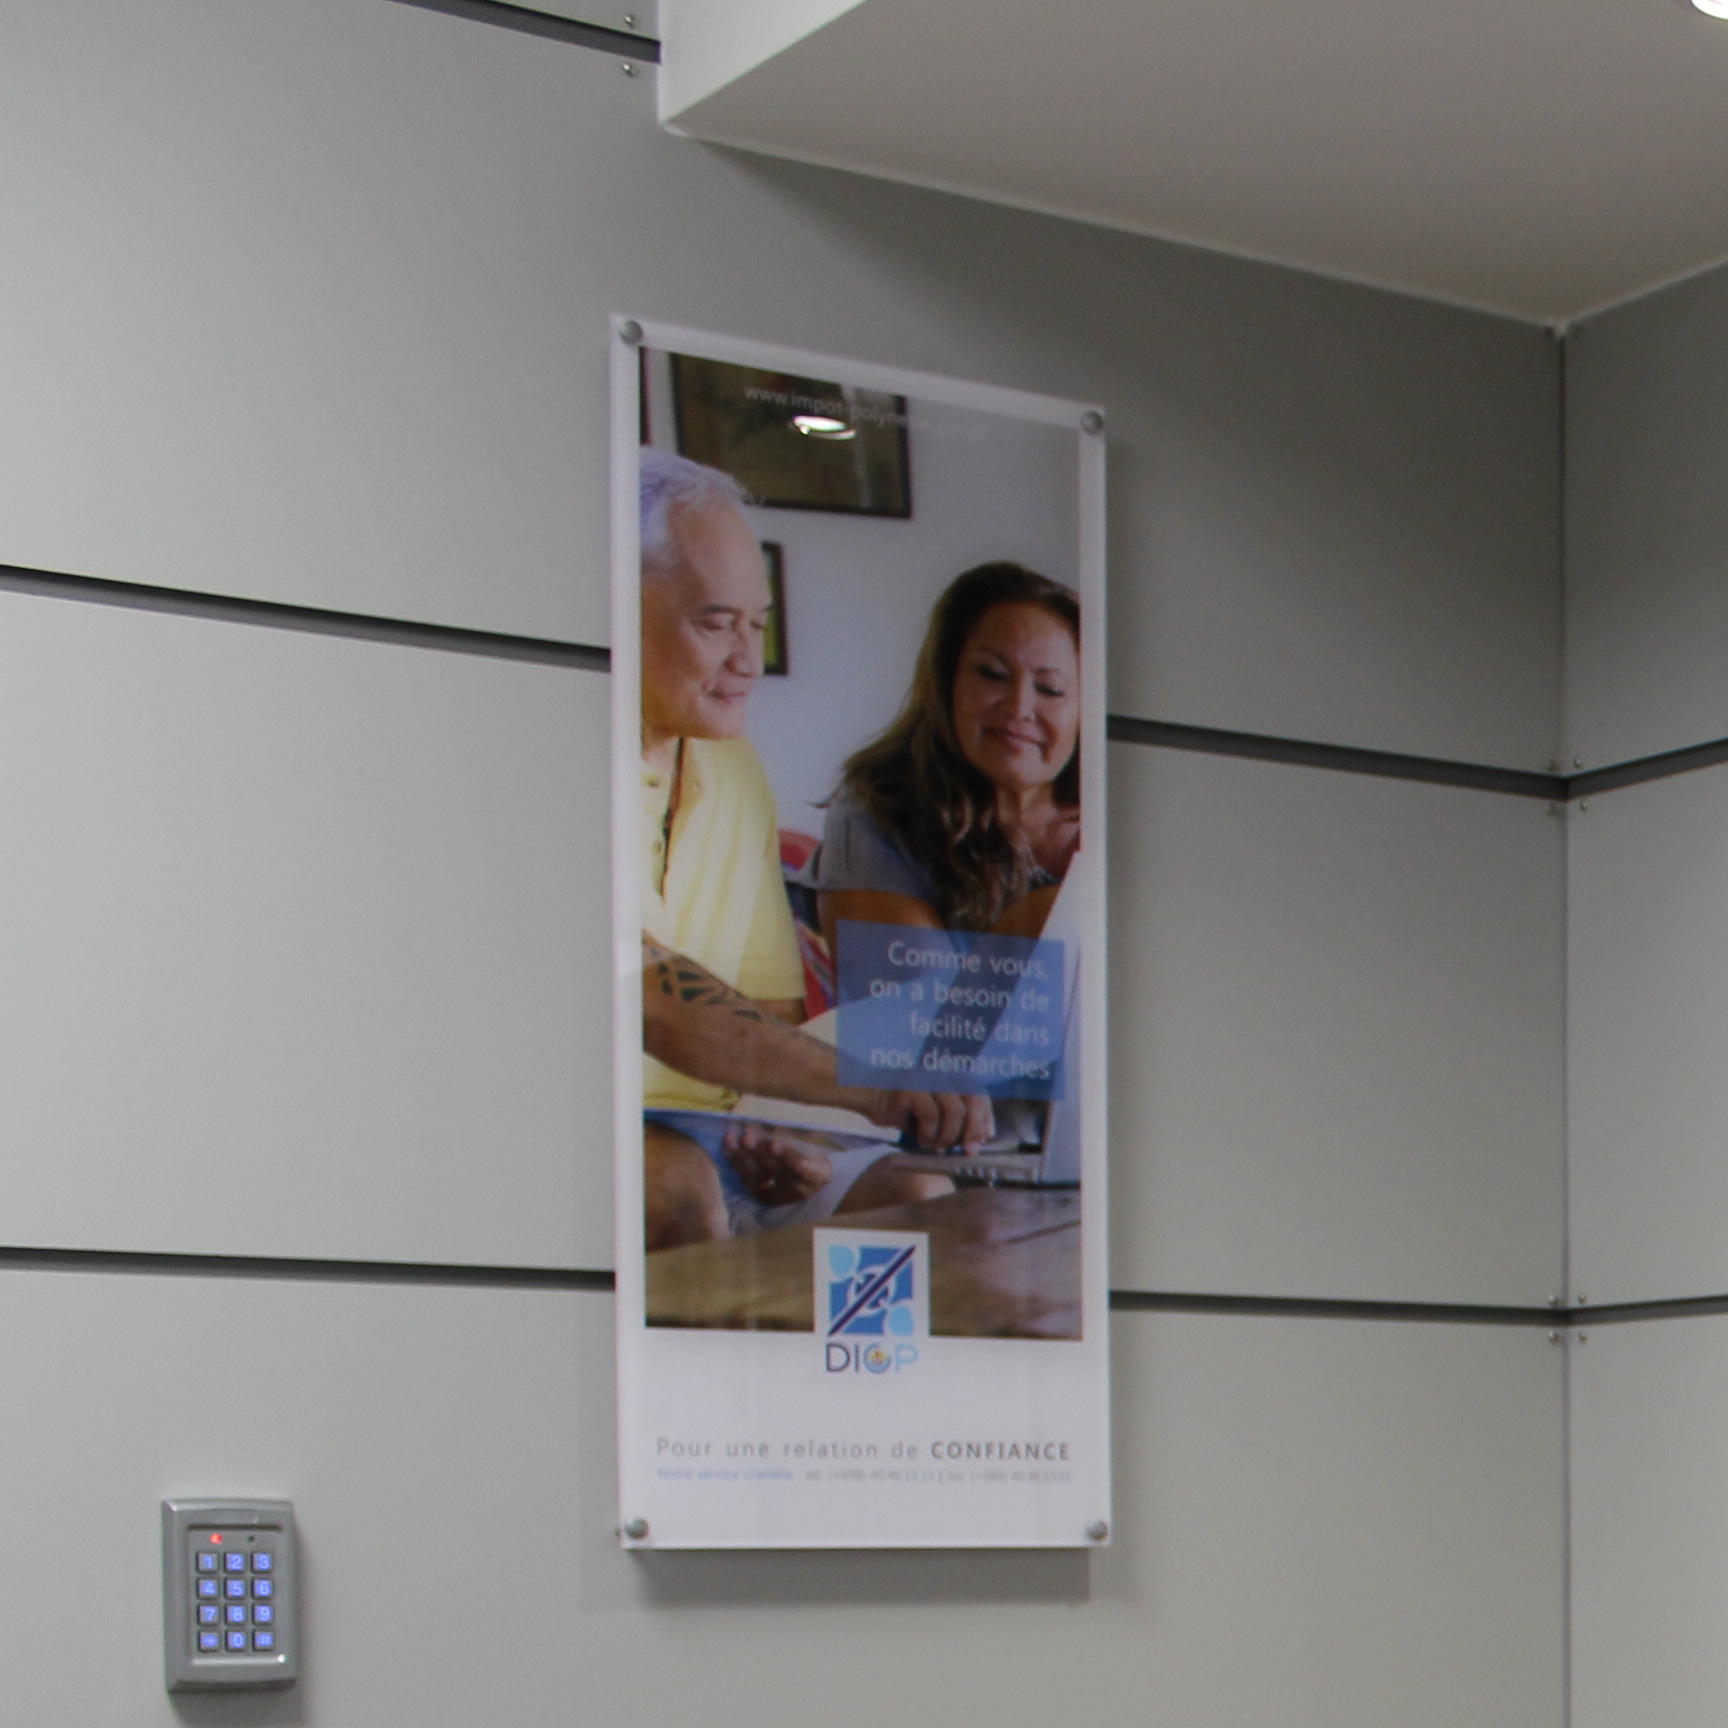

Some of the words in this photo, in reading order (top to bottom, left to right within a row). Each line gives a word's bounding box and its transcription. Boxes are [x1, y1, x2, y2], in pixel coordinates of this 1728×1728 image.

[887, 940, 982, 974] Comme
[869, 978, 901, 1000] on
[909, 984, 924, 1001] a
[933, 979, 1012, 1010] besoin
[1019, 988, 1049, 1014] de
[909, 1010, 986, 1042] facilité
[996, 1020, 1049, 1046] dans
[870, 1049, 913, 1070] nos
[922, 1048, 1050, 1081] démarches
[656, 1437, 713, 1459] Pour
[726, 1442, 770, 1459] une
[782, 1438, 877, 1460] relation
[890, 1440, 920, 1460] de
[929, 1439, 1071, 1462] CONFIANCE
